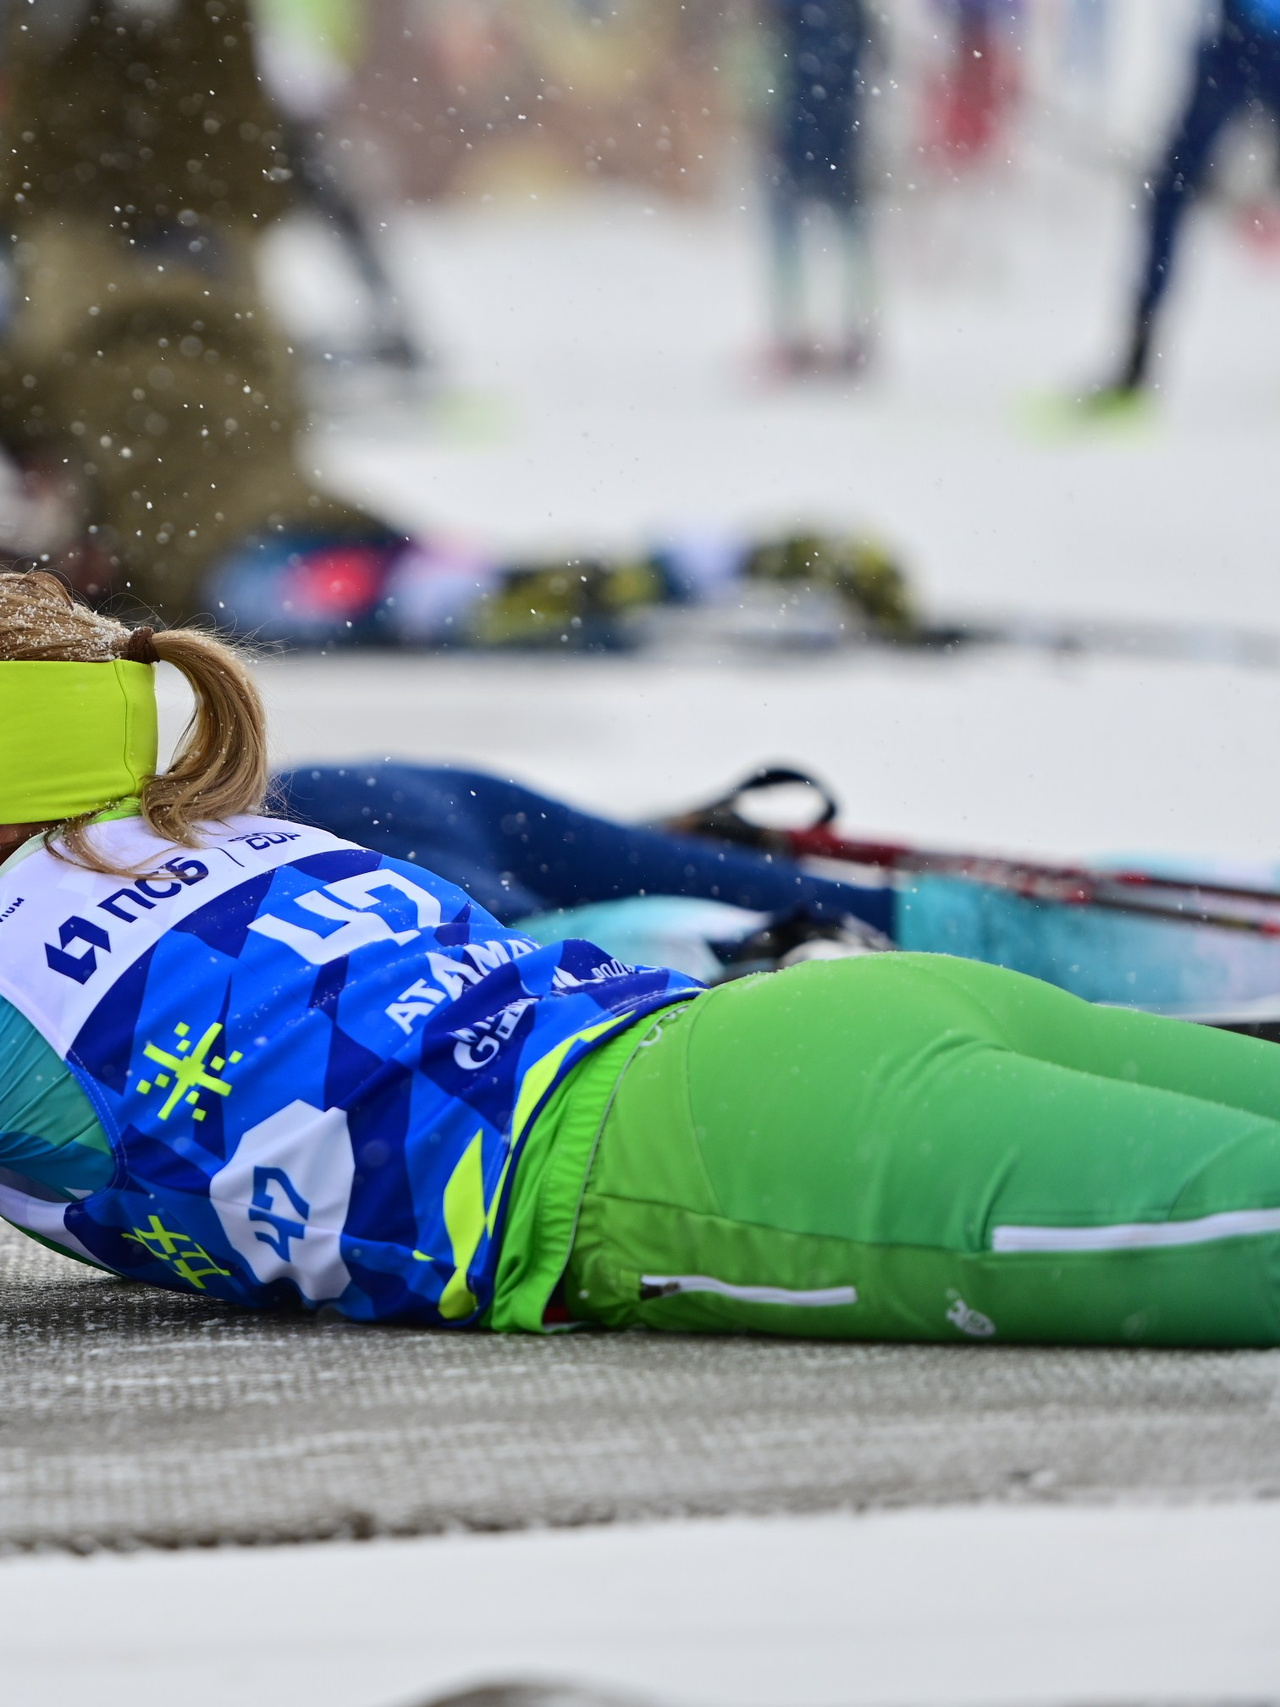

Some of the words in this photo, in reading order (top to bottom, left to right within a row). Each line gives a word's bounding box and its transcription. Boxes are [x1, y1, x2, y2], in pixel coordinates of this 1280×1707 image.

[96, 857, 209, 923] ПСБ
[246, 868, 442, 965] 47
[248, 1166, 310, 1262] 47
